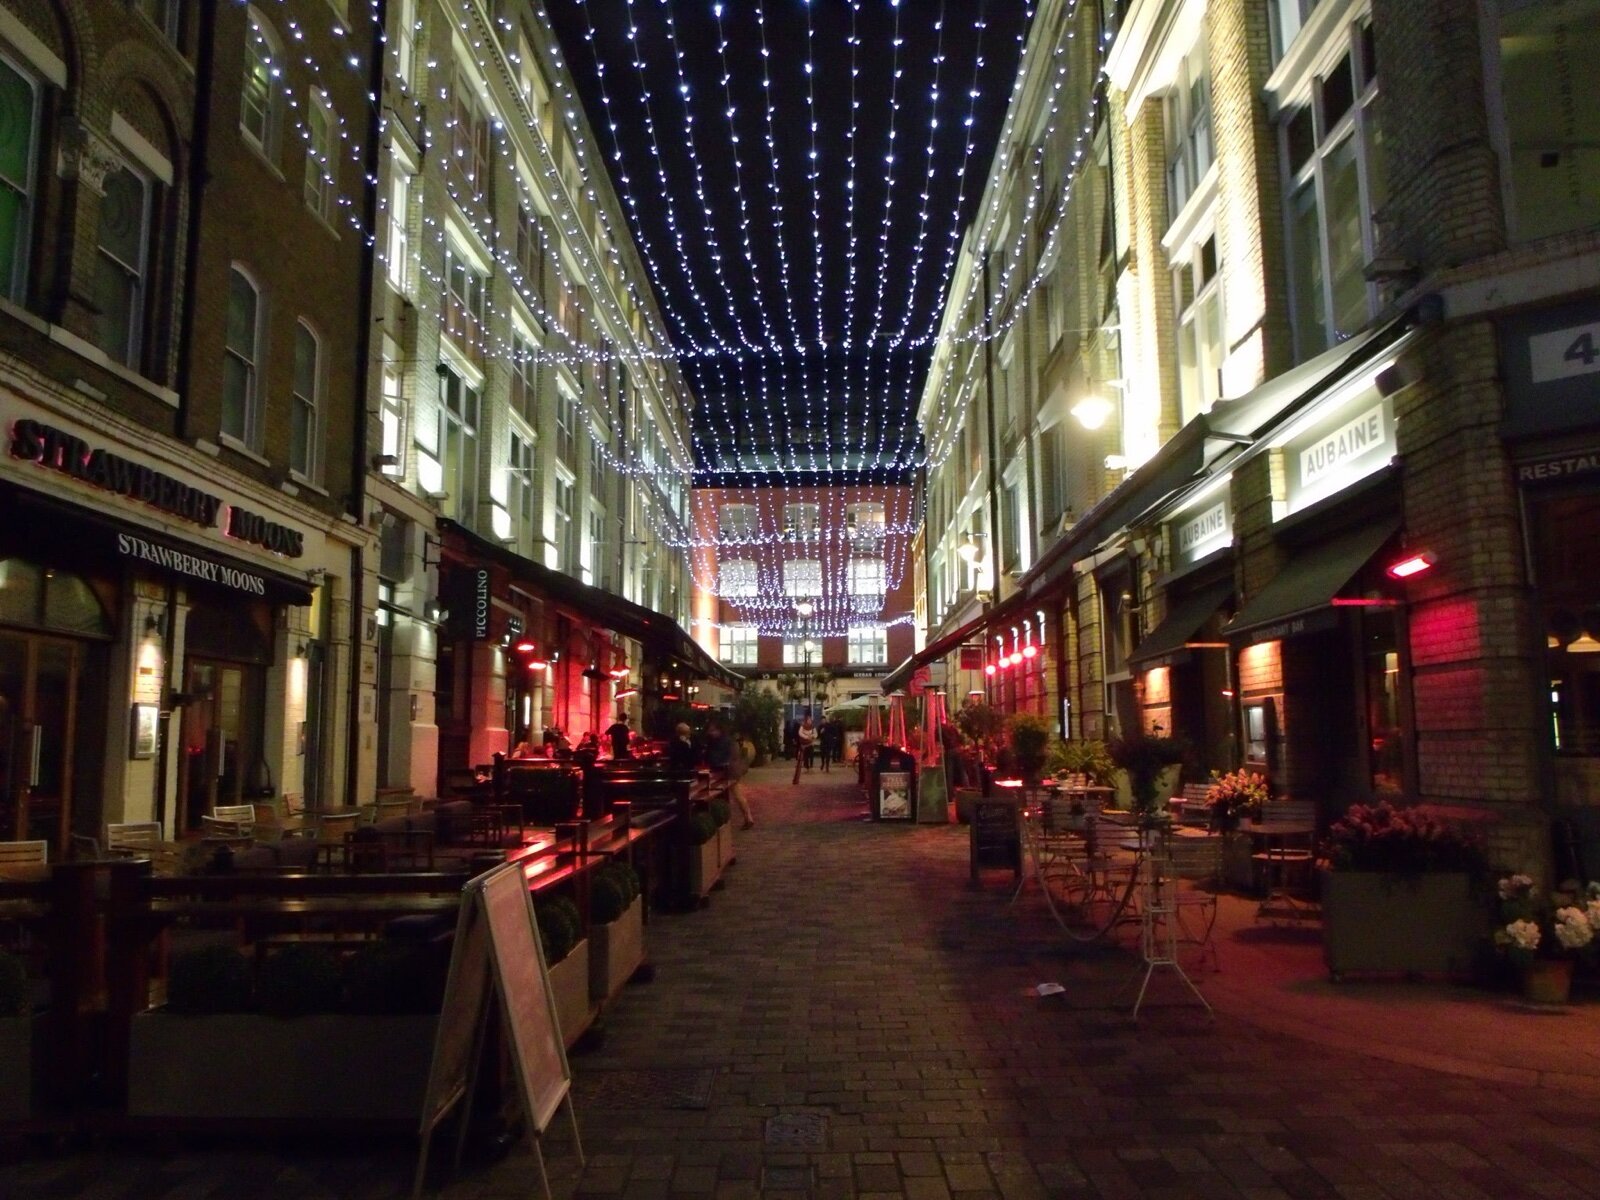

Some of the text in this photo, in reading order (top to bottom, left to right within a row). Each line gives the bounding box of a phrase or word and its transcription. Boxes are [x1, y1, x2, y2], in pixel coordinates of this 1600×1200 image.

[1305, 412, 1381, 478] AUBAINE
[10, 419, 304, 558] STRAWBERRY MOONS
[1181, 506, 1224, 548] AUBAINE
[117, 532, 265, 596] STRAWBERRY MOONS
[476, 570, 488, 637] PICCOLINO
